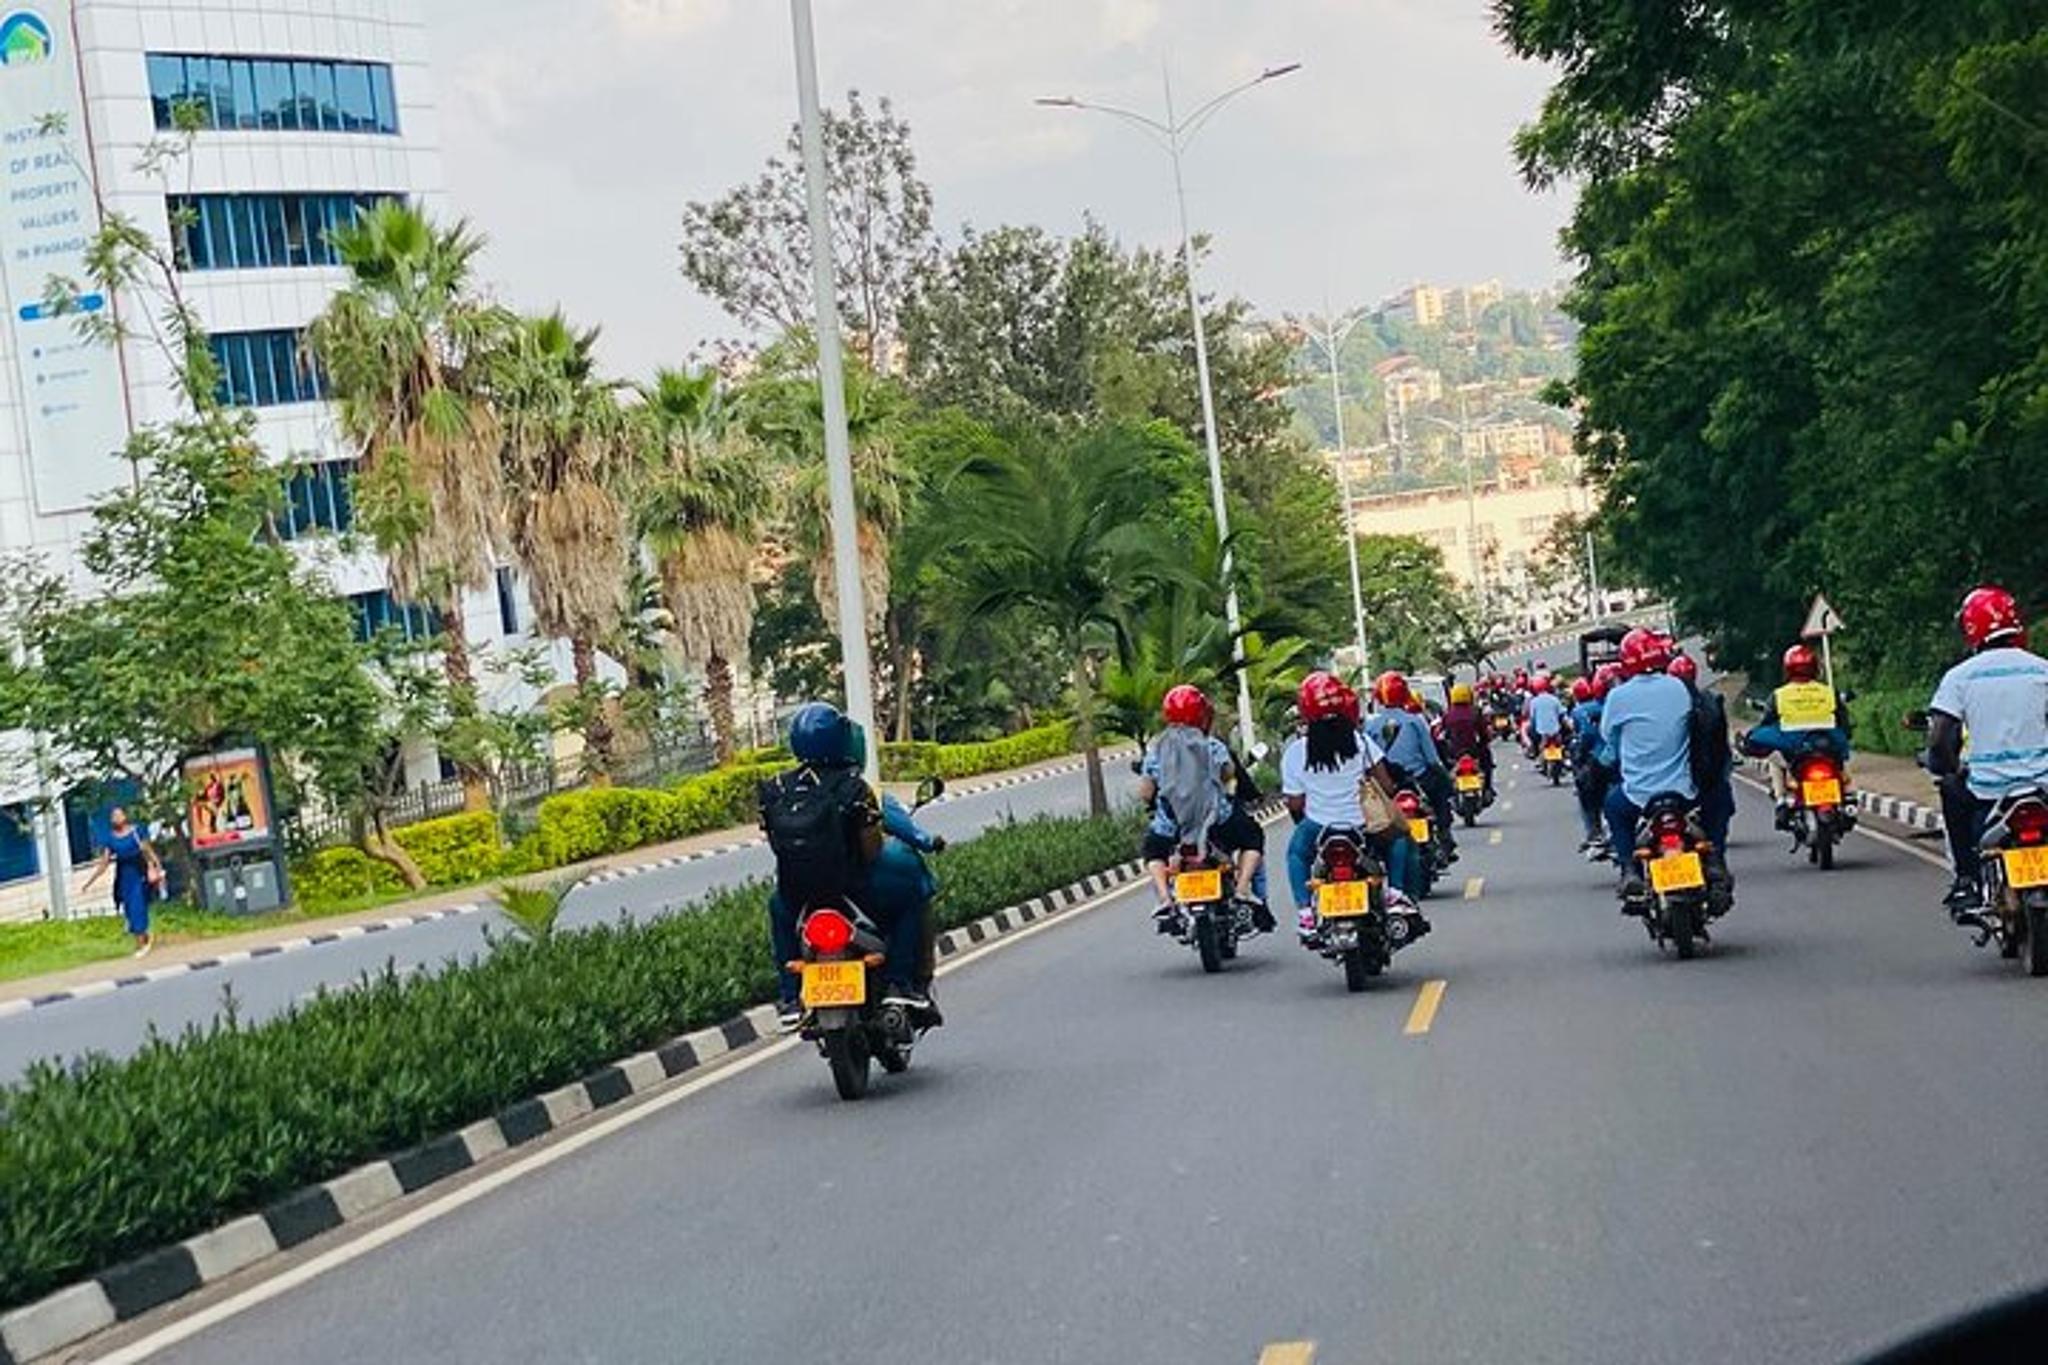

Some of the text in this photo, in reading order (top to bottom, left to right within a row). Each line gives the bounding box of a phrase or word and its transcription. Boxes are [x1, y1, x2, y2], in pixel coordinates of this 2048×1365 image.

[10, 157, 28, 174] OF
[10, 181, 78, 203] PROPERTY
[20, 208, 79, 230] VALUERS
[33, 236, 87, 257] RWANDA
[818, 965, 841, 982] RH
